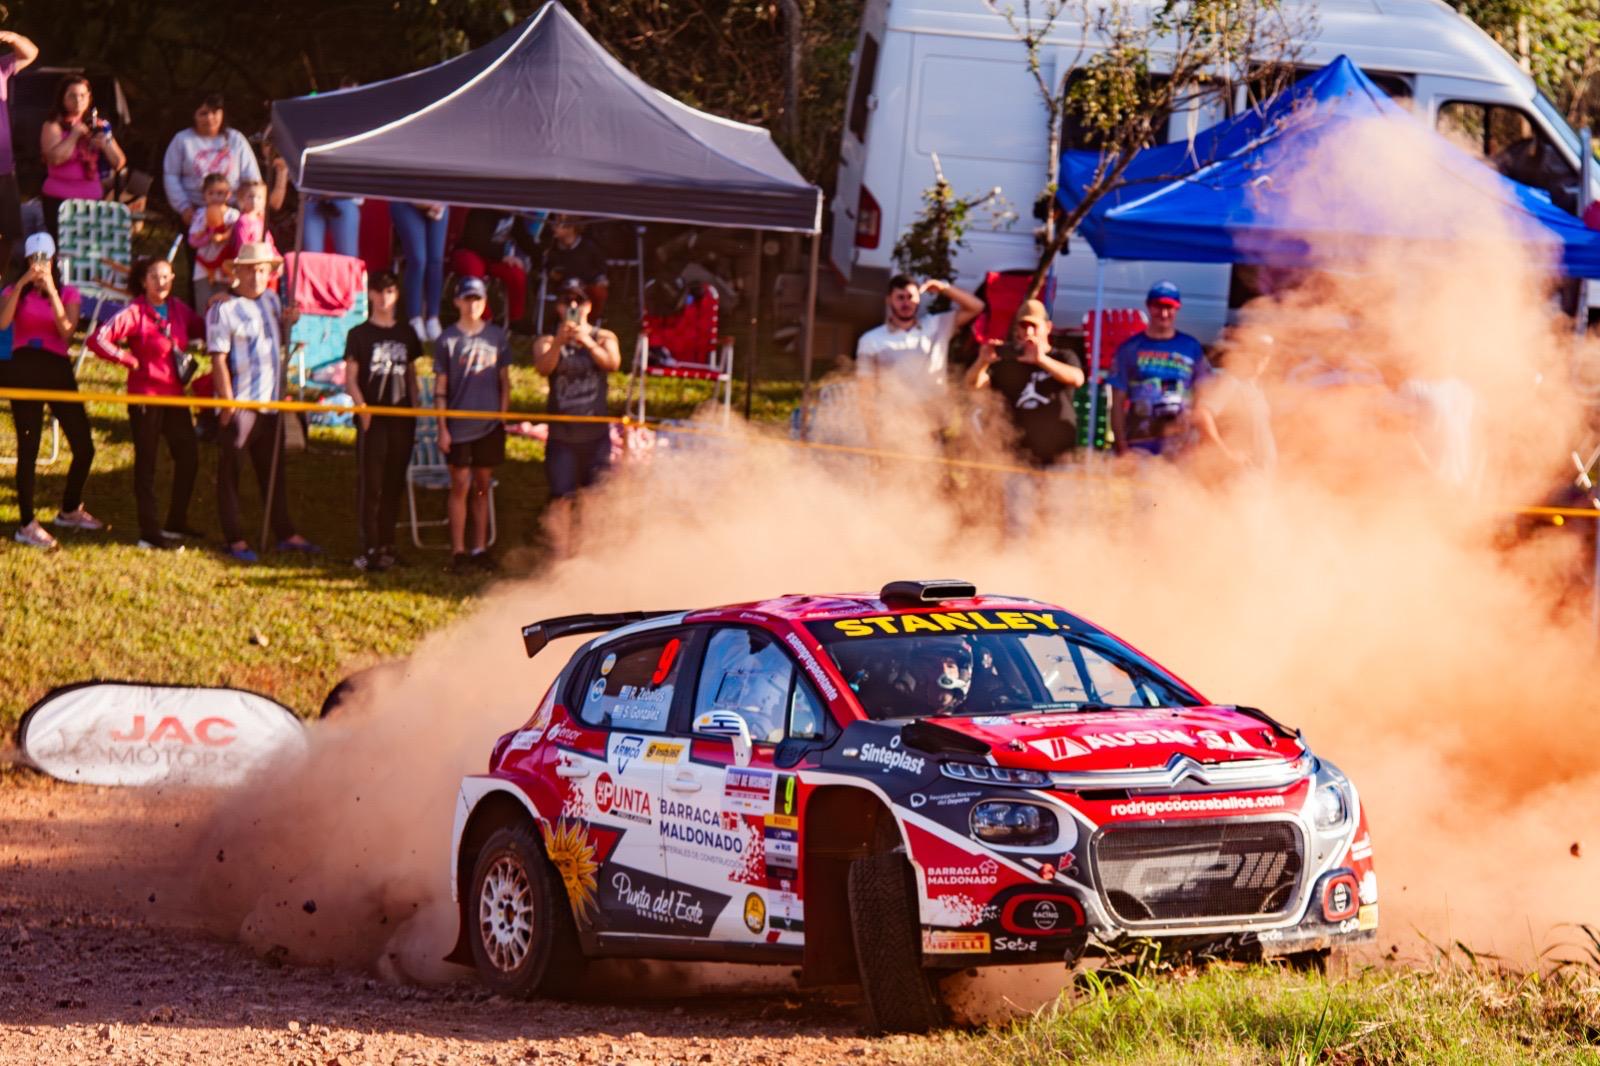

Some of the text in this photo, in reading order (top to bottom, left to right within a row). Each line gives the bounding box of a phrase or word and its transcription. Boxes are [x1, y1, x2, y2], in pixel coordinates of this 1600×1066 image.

[109, 714, 237, 746] JAC
[108, 745, 239, 769] MOTORS
[612, 744, 640, 758] ARMCO
[859, 743, 925, 774] Sinteplast
[602, 781, 652, 816] PUNTA
[784, 775, 795, 815] 9
[1110, 793, 1285, 816] rodrigococozeballos.com
[660, 798, 720, 827] BARRACA
[660, 820, 743, 853] MALDONADO
[928, 867, 978, 876] BARRACA
[928, 876, 997, 885] MALDONADO
[612, 872, 703, 925] Punta del Este
[1032, 911, 1059, 919] RACING
